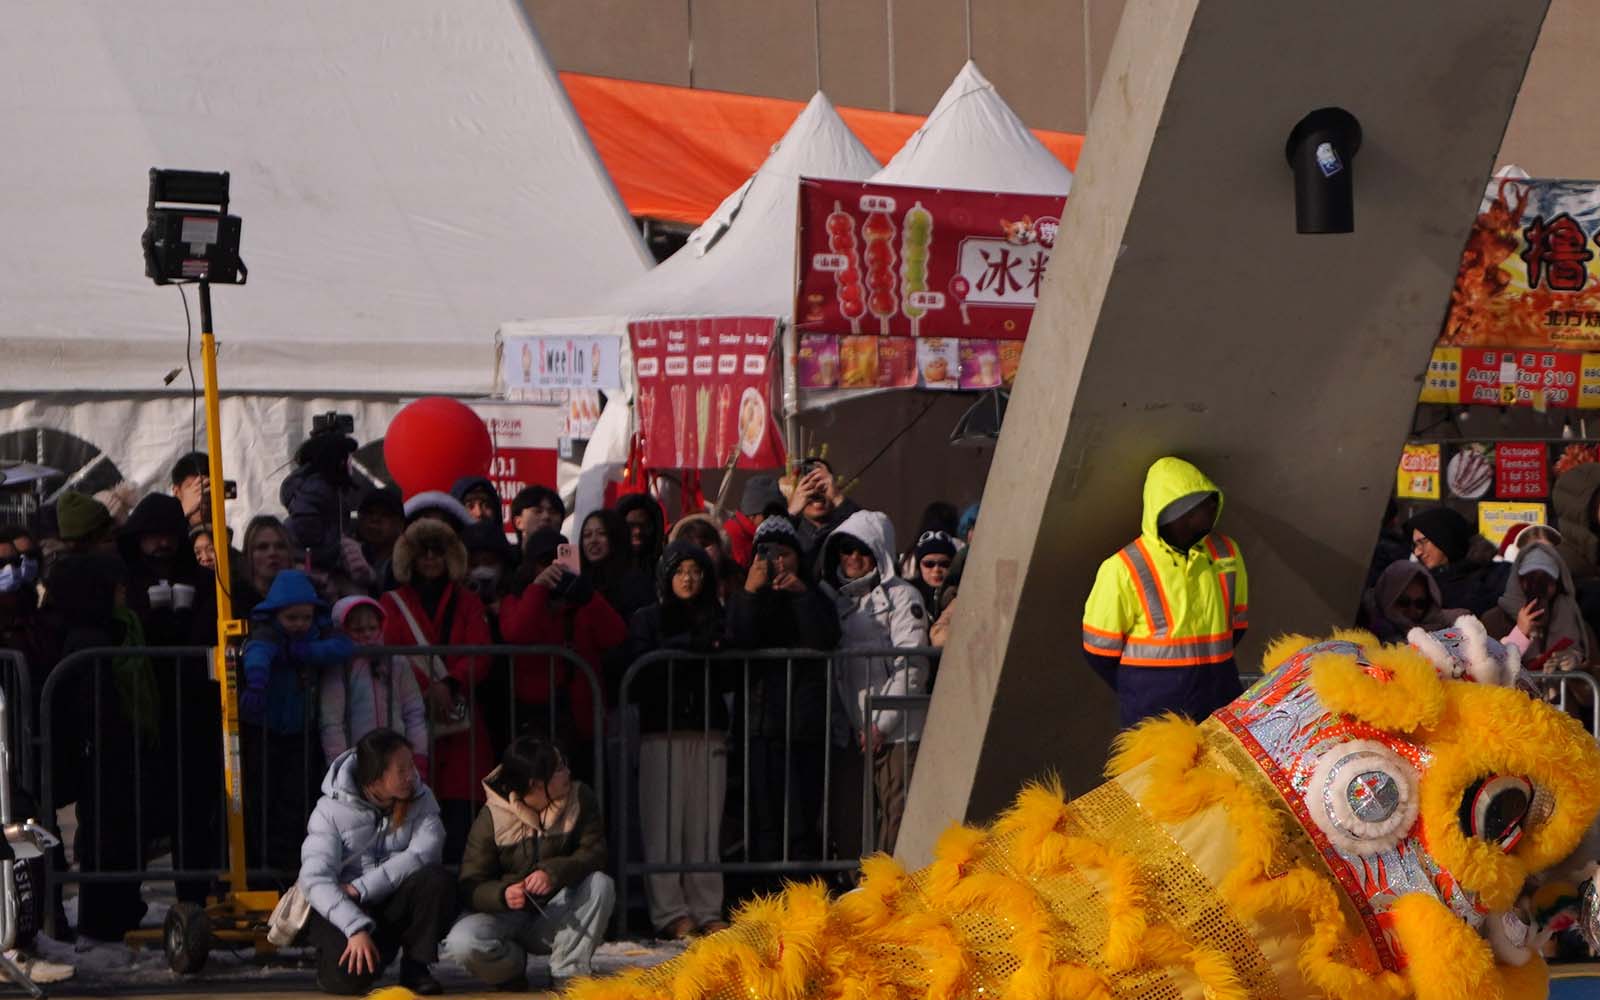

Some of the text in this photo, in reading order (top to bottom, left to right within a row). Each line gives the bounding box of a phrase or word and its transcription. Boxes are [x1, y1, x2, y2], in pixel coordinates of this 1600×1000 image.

[1467, 367, 1575, 386] Any for $10
[1473, 386, 1500, 401] Any
[1503, 386, 1514, 402] 5
[1515, 384, 1531, 400] fo
[1500, 446, 1540, 456] Octopus
